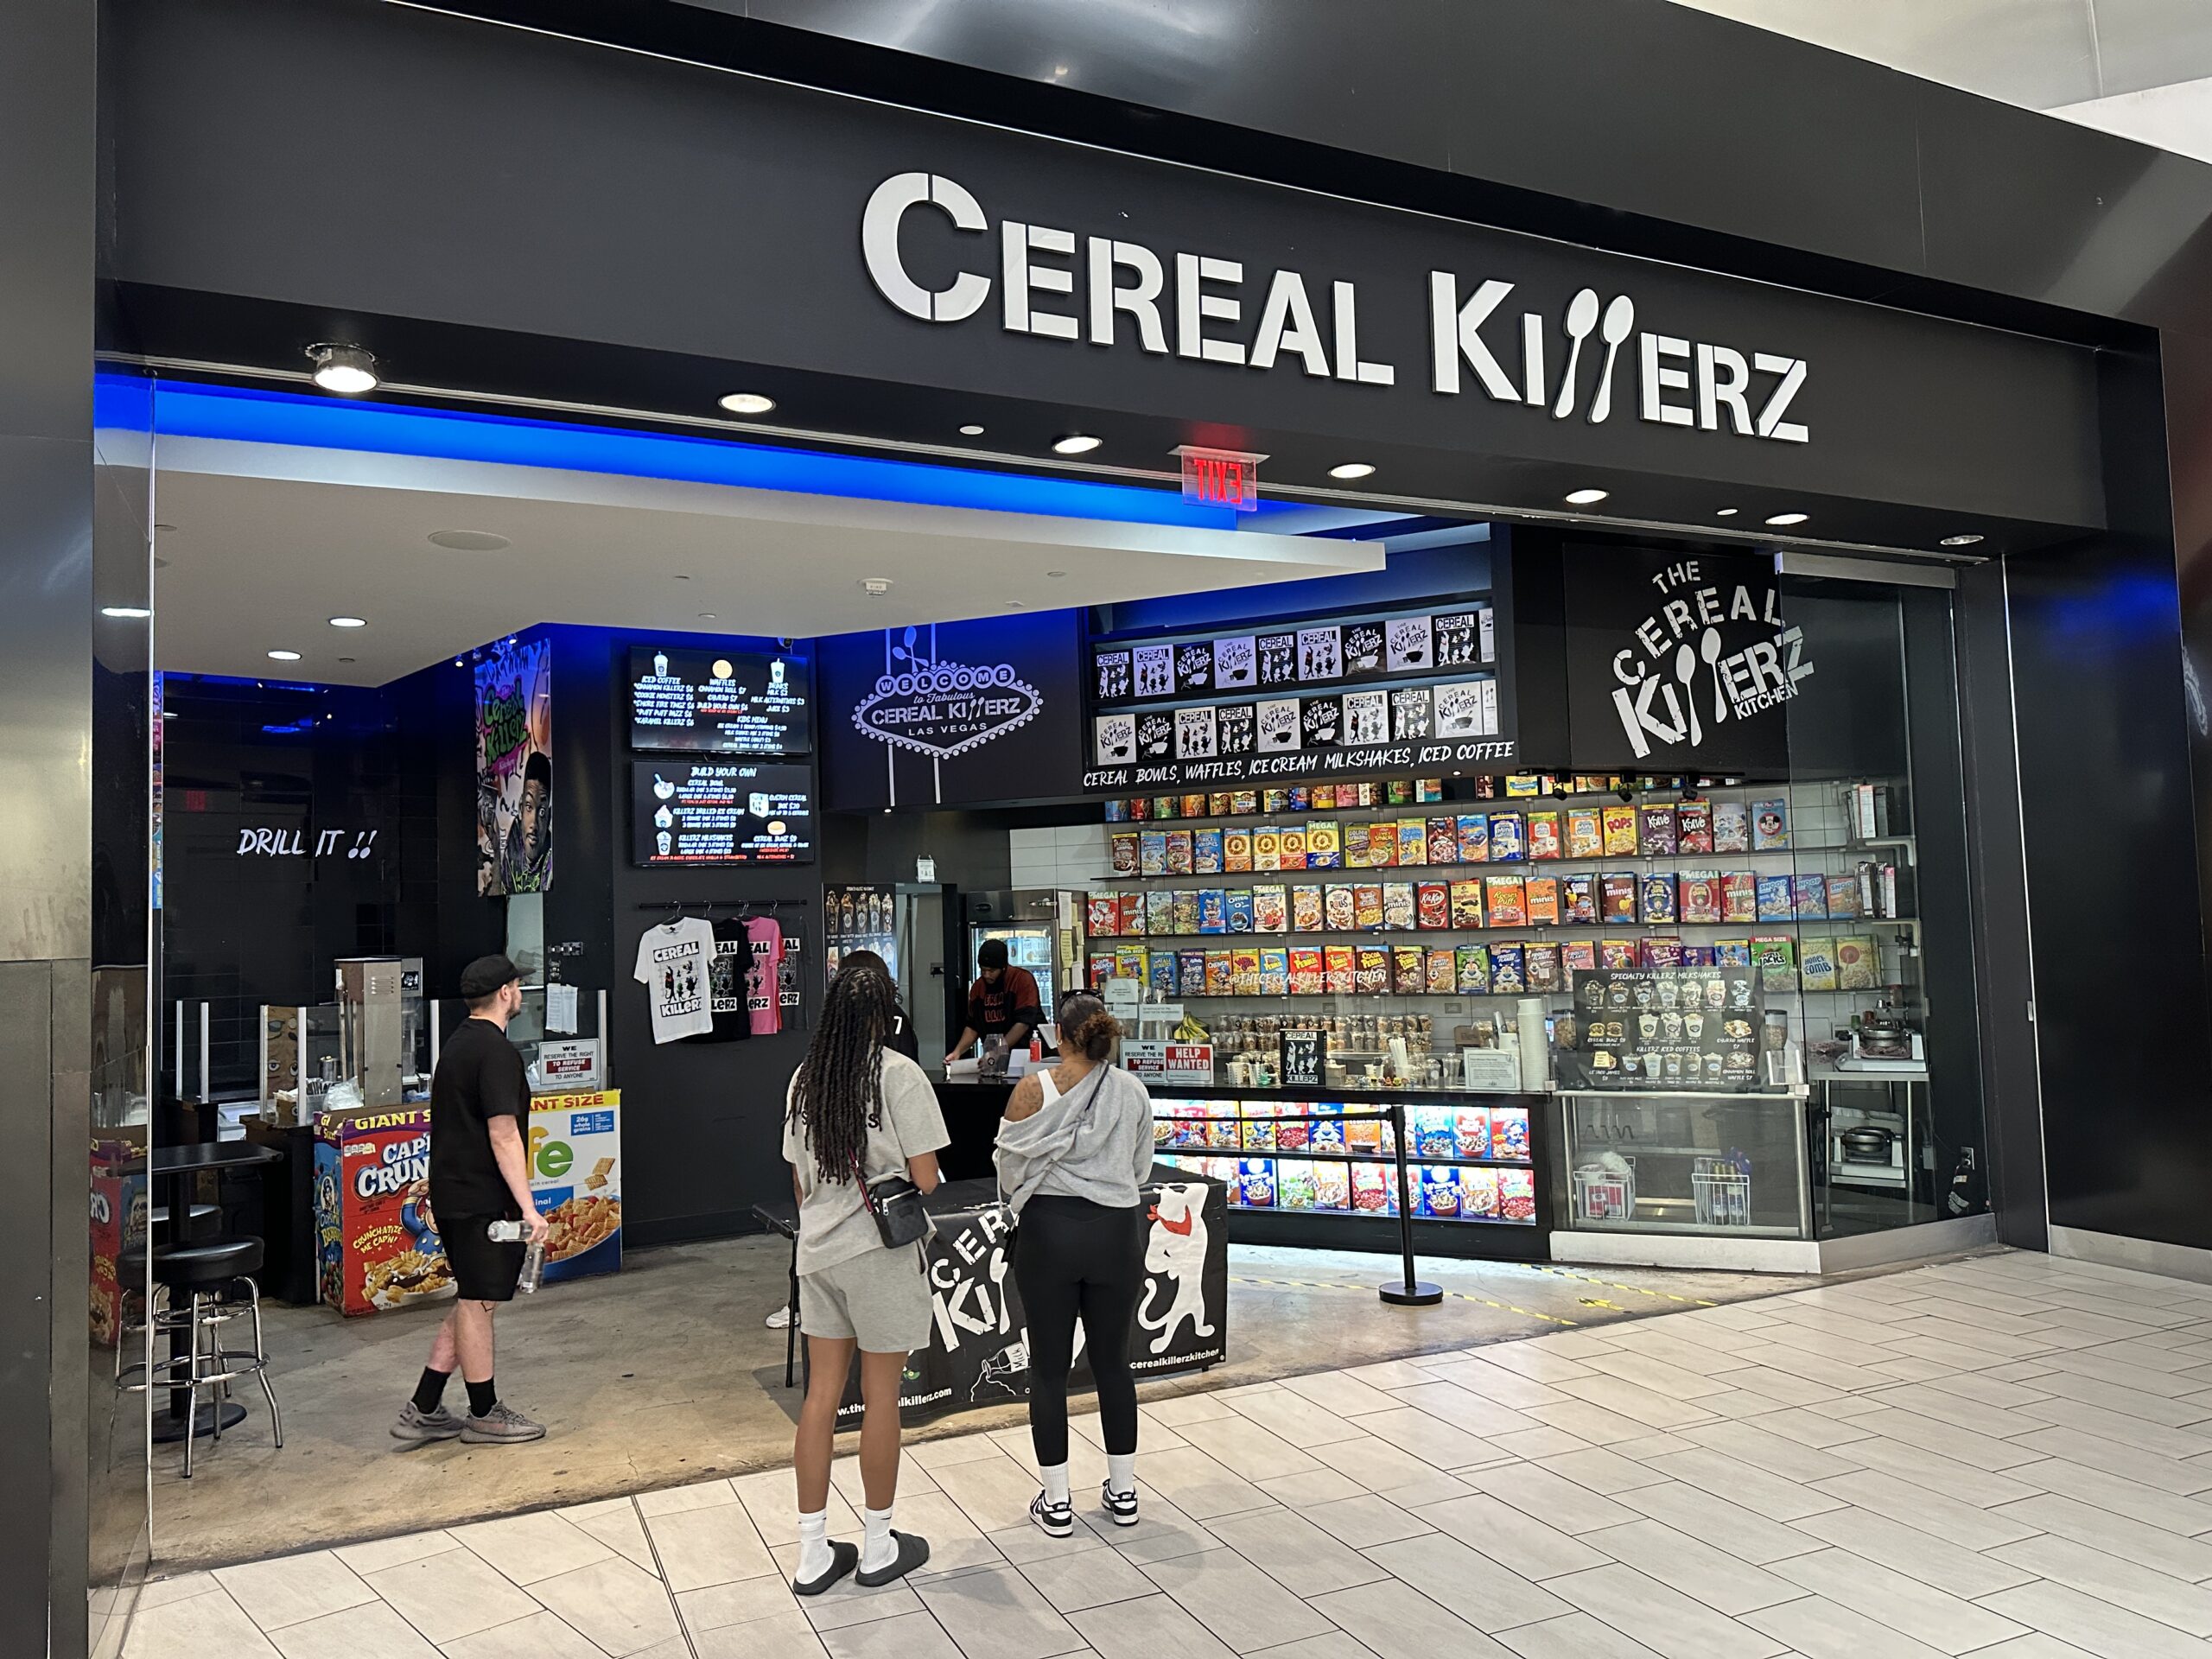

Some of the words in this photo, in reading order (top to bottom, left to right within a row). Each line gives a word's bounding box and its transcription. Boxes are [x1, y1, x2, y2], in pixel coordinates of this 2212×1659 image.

[861, 170, 1395, 388] CEREAL
[1652, 561, 1700, 594] THE
[1436, 615, 1473, 629] CEREAL
[1301, 631, 1336, 645] CEREAL
[1613, 585, 1786, 685] CEREAL
[1259, 637, 1293, 649] CEREAL
[1097, 653, 1128, 665] CEREAL
[1137, 650, 1169, 662] CEREAL
[878, 668, 1011, 694] WELCOME
[913, 695, 925, 703] to
[926, 691, 975, 703] Fabulous
[1347, 696, 1382, 709] CEREAL
[1392, 691, 1429, 704] CEREAL
[1734, 683, 1799, 720] KITCHEN
[871, 703, 943, 725] CEREAL
[1179, 710, 1211, 723] CEREAL
[1219, 707, 1252, 720] CEREAL
[908, 726, 934, 736] LAS
[940, 722, 988, 733] VEGAS
[1084, 770, 1128, 787] CEREAL
[1135, 765, 1180, 785] BOWLS,
[1185, 760, 1245, 780] WAFFLES,
[1249, 758, 1270, 776] ICE
[1271, 753, 1318, 775] CREAM
[1325, 747, 1414, 770] MILKSHAKES,
[1418, 745, 1452, 764] ICED
[1457, 741, 1515, 761] COFFEE
[690, 766, 715, 777] BUILD
[715, 767, 738, 777] YOUR
[739, 767, 757, 778] OWN
[1607, 817, 1633, 834] POPS
[237, 828, 306, 857] DRILL
[315, 830, 345, 857] IT
[1760, 880, 1787, 890] SNOOP
[1529, 895, 1554, 905] minis
[1726, 889, 1754, 898] minis
[653, 942, 699, 962] CEREAL
[716, 942, 736, 954] EAL
[750, 942, 769, 954] EAL
[1092, 962, 1115, 970] CRUNCH
[1759, 956, 1785, 966] JACKS
[1804, 962, 1832, 975] COMB
[894, 1016, 902, 1034] 7
[1176, 1047, 1200, 1058] HELP
[1168, 1058, 1209, 1070] WANTED
[563, 1094, 604, 1109] SIZE
[354, 1110, 417, 1130] GIANT
[383, 1132, 430, 1164] CAP'
[526, 1126, 574, 1179] fe
[358, 1156, 430, 1198] CRUN
[535, 1197, 551, 1205] inal
[360, 1243, 372, 1254] ME
[931, 1209, 1011, 1288] CER
[1014, 1347, 1026, 1369] Milk
[1129, 1348, 1219, 1370] cerealkillerzkitchen
